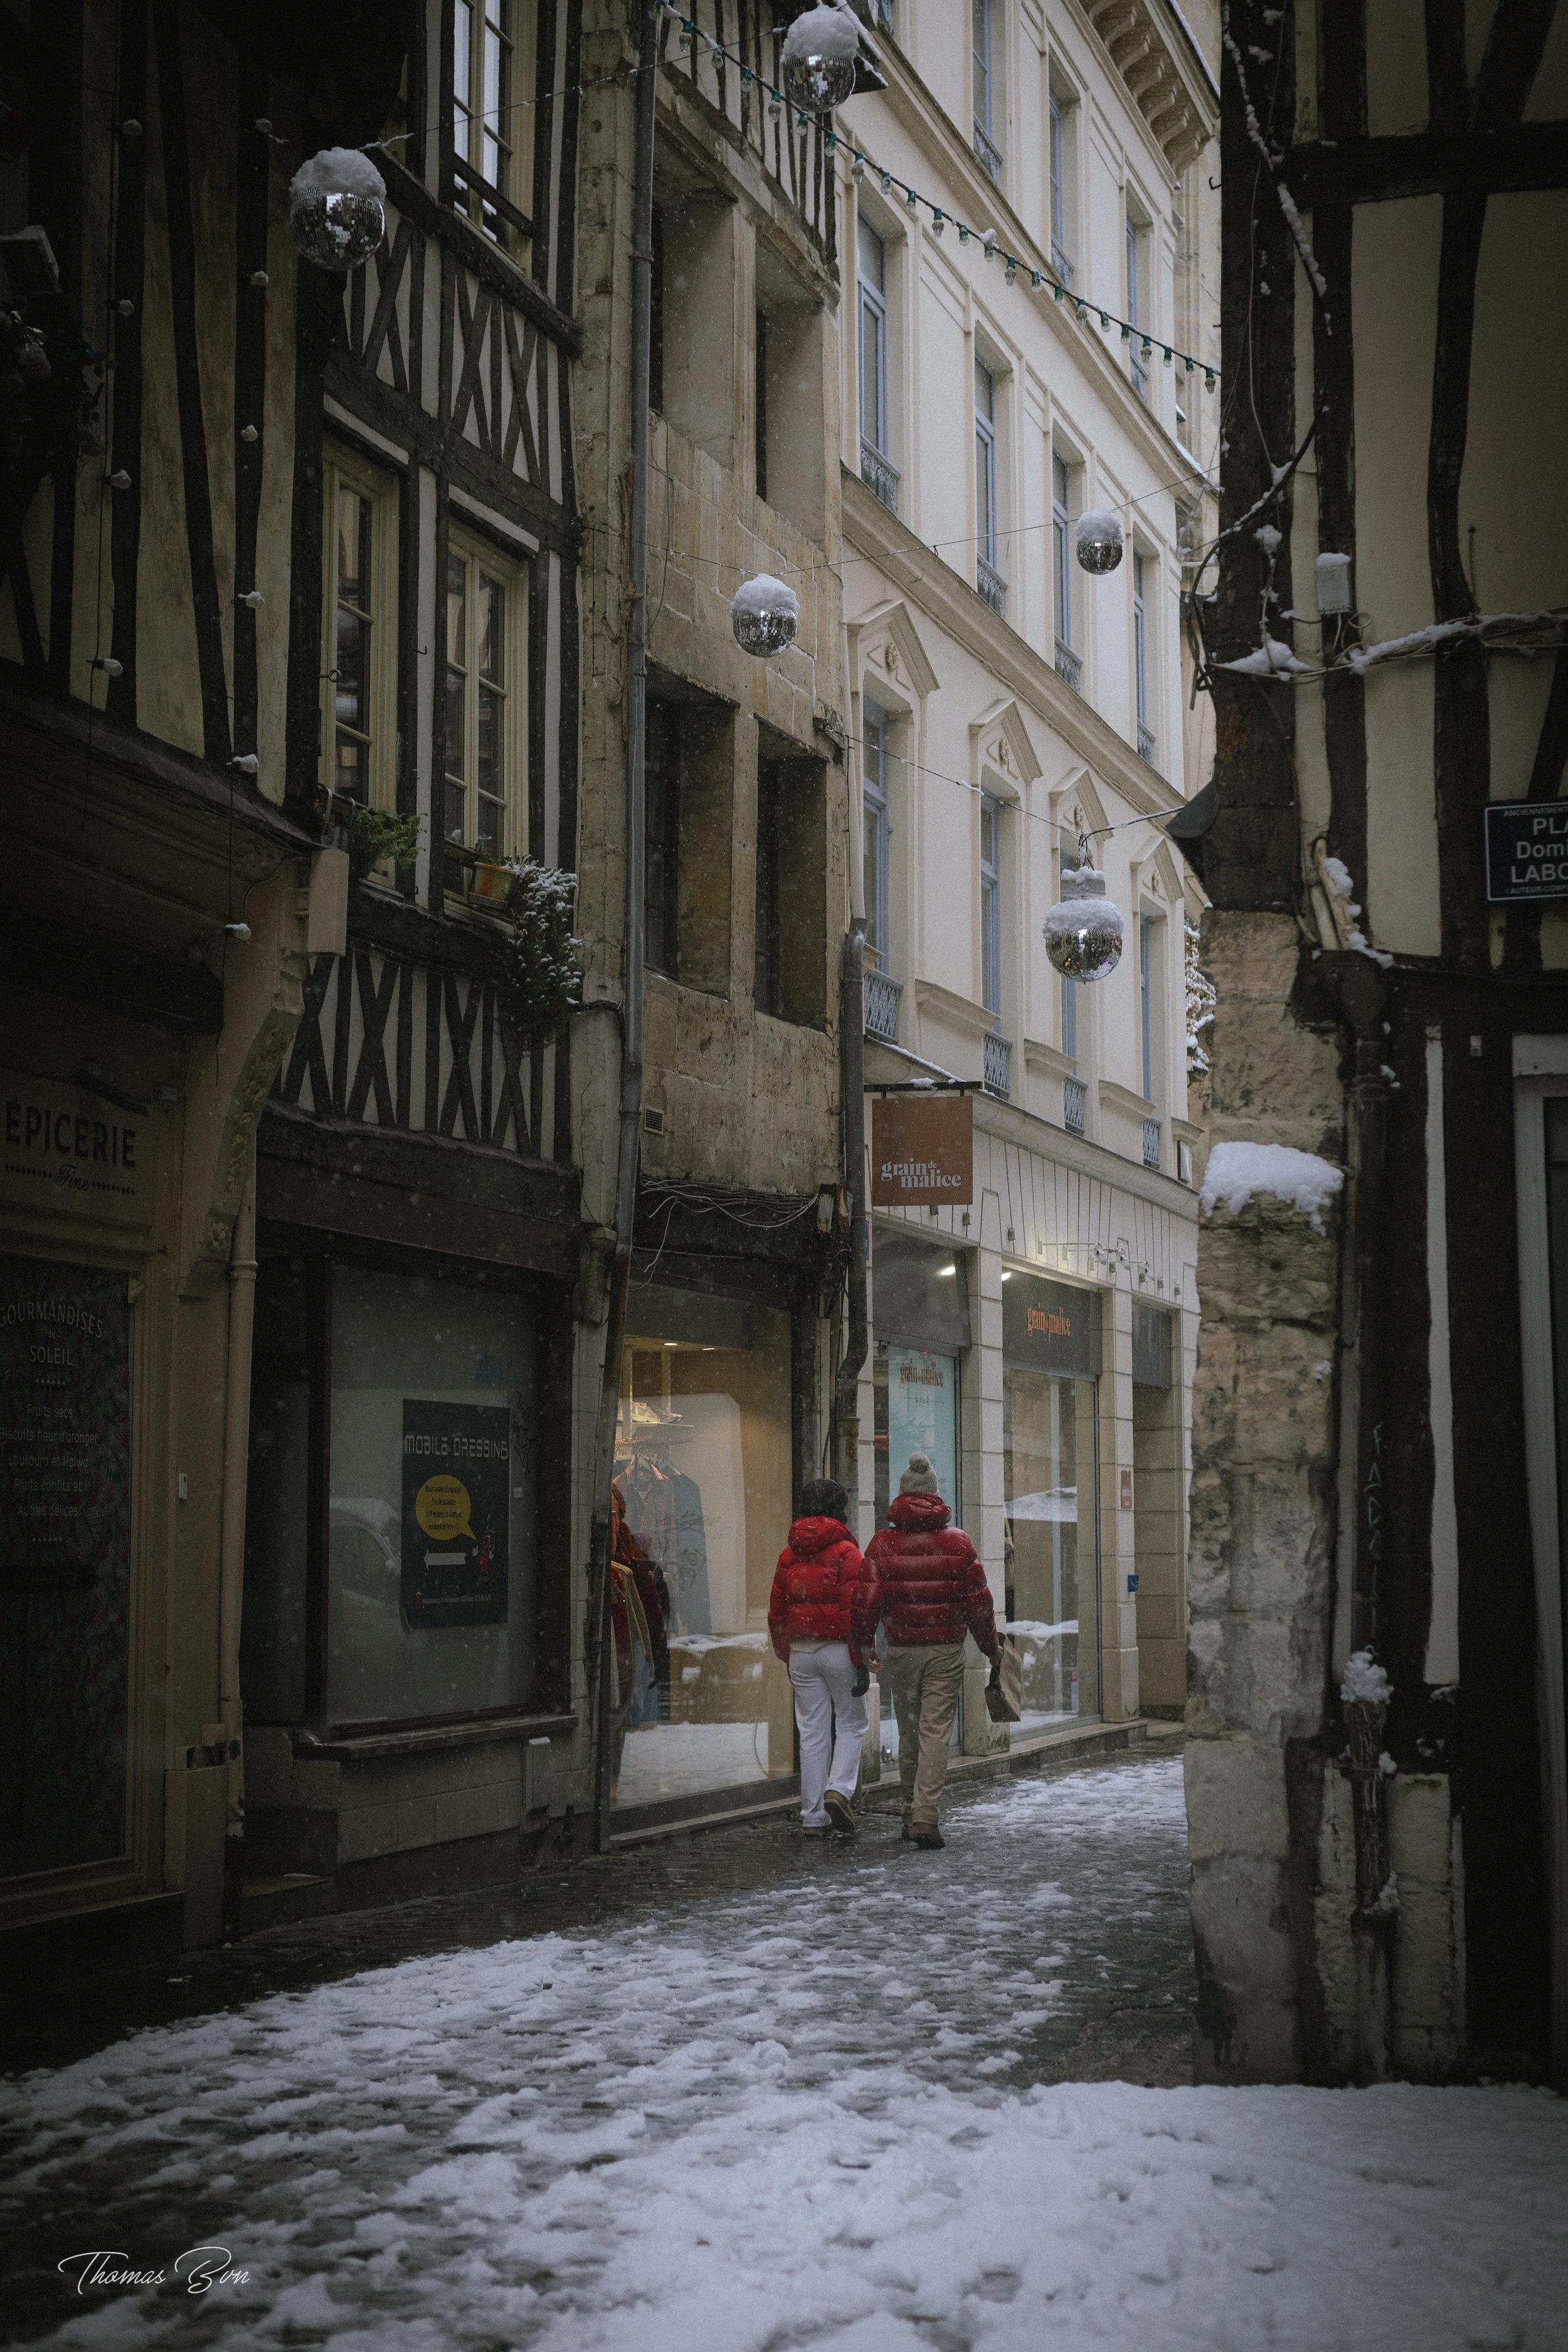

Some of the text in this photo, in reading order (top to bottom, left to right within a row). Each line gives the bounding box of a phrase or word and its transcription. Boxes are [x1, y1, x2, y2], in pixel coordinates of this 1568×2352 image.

[1503, 806, 1568, 817] ANCIENNEMENT
[5, 1097, 135, 1167] ÉPICERIE
[54, 1164, 90, 1190] Fine
[881, 1158, 937, 1181] grain de
[901, 1169, 963, 1188] malice
[0, 1301, 103, 1338] GOURMANDISES
[1027, 1302, 1046, 1337] grain
[1049, 1306, 1071, 1337] malice
[30, 1345, 73, 1365] SOLEIL
[921, 1362, 944, 1387] malice
[27, 1404, 73, 1418] Fruits secs
[0, 1428, 34, 1441] Biscuits
[60, 1431, 98, 1446] d'oranger
[405, 1434, 508, 1459] MOBILE DRESSING
[8, 1453, 48, 1466] Loukoum
[51, 1456, 60, 1467] et
[13, 1478, 82, 1492] Fruits confits et
[18, 1505, 46, 1517] Autres
